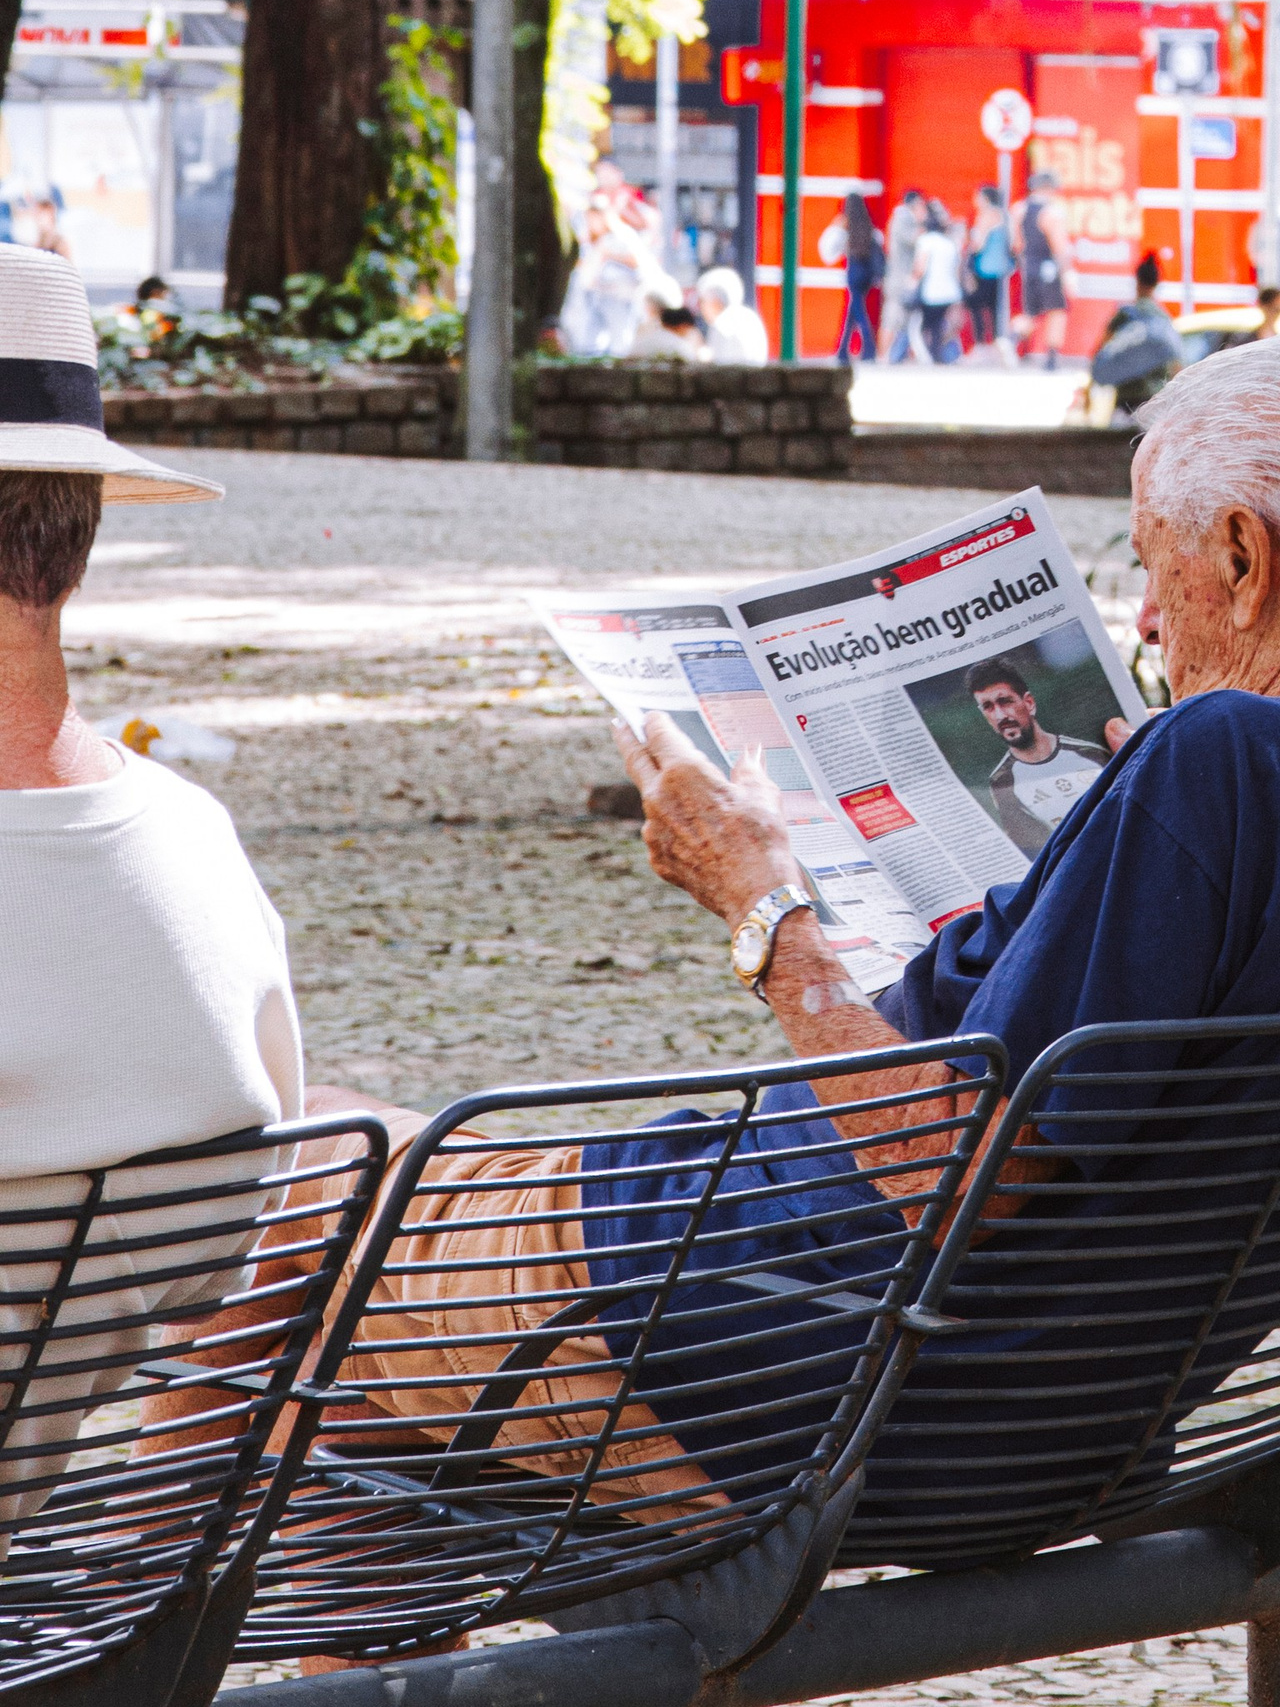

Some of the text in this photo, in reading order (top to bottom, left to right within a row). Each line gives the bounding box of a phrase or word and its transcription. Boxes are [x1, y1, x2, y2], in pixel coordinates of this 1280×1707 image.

[940, 525, 1016, 568] ESPORTES
[766, 631, 881, 682] Evolução
[875, 614, 943, 652] bem
[941, 558, 1059, 639] gradual
[990, 622, 1020, 640] assusta
[1027, 601, 1066, 626] Mengão
